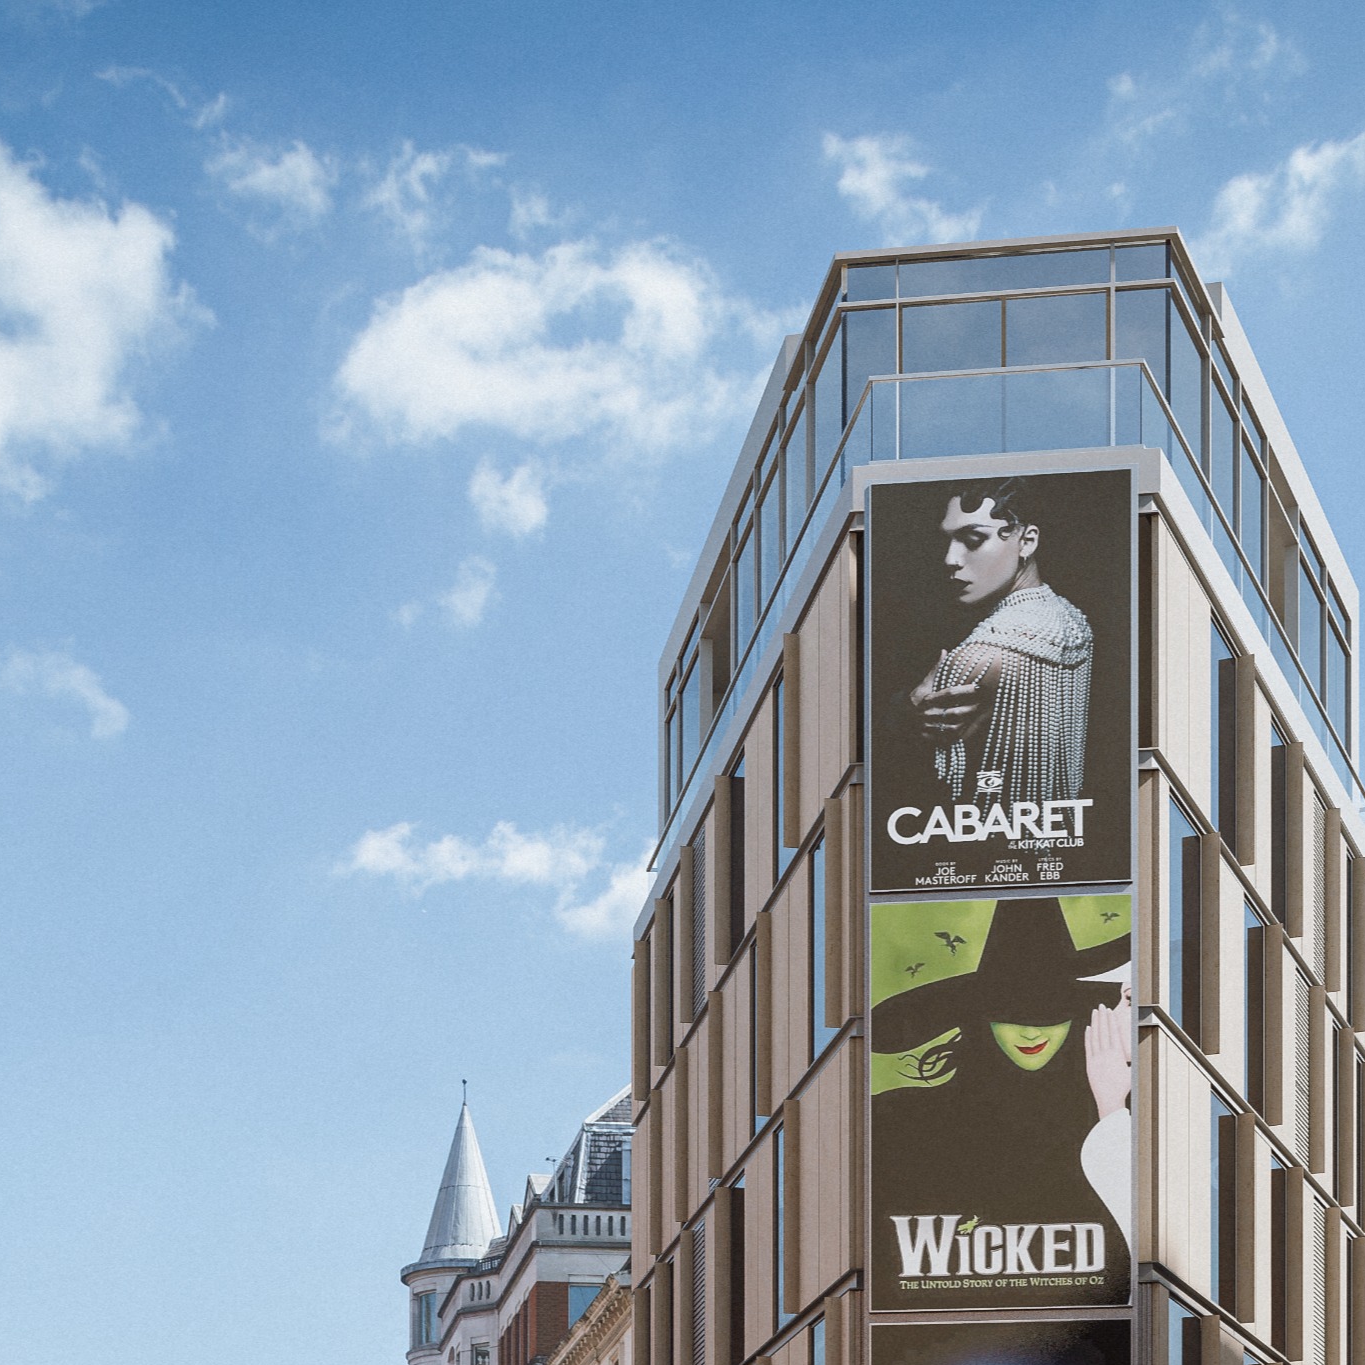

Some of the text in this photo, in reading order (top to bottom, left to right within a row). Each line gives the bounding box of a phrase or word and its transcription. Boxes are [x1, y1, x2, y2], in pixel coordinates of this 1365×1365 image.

[887, 799, 1093, 845] CABARET
[1057, 838, 1084, 847] CLUB
[991, 864, 1022, 874] JOHN
[1036, 862, 1064, 871] FRED
[936, 867, 956, 876] JOE
[1040, 872, 1060, 880] EBB
[915, 875, 977, 885] MASTEROFF
[985, 873, 1029, 882] KANDER
[900, 1280, 918, 1289] THE
[921, 1280, 961, 1288] UNTOLD
[963, 1279, 994, 1288] STORY
[995, 1279, 1008, 1287] OF
[1009, 1279, 1027, 1287] THE
[1030, 1277, 1073, 1286] WITCHES
[1075, 1277, 1087, 1285] OF
